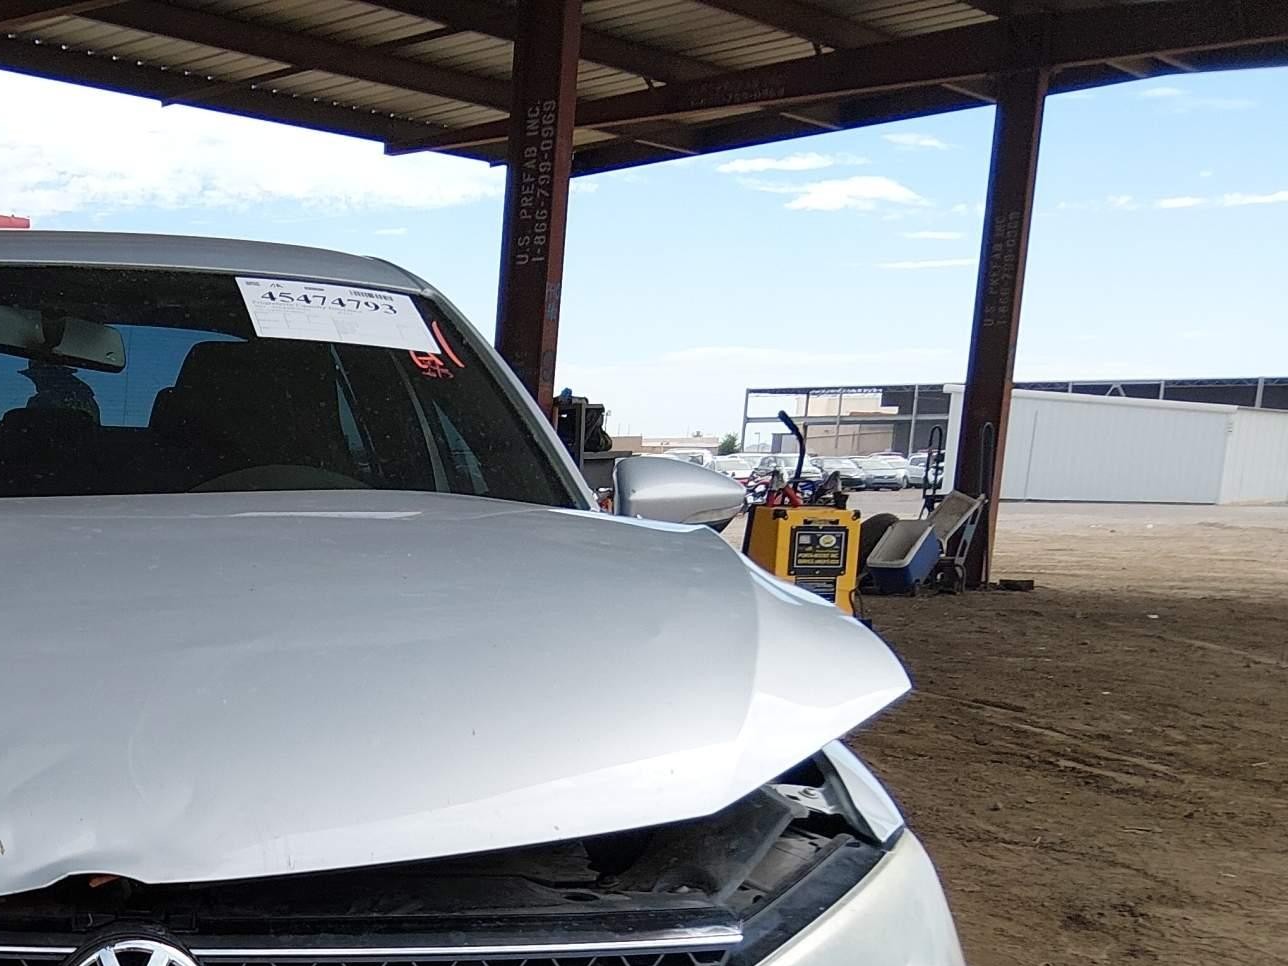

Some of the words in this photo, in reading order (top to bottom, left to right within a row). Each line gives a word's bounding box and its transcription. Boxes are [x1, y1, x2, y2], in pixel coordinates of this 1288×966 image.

[519, 147, 538, 219] PREFAB
[532, 99, 557, 263] 1-866-799-0969
[260, 290, 398, 315] 45474793
